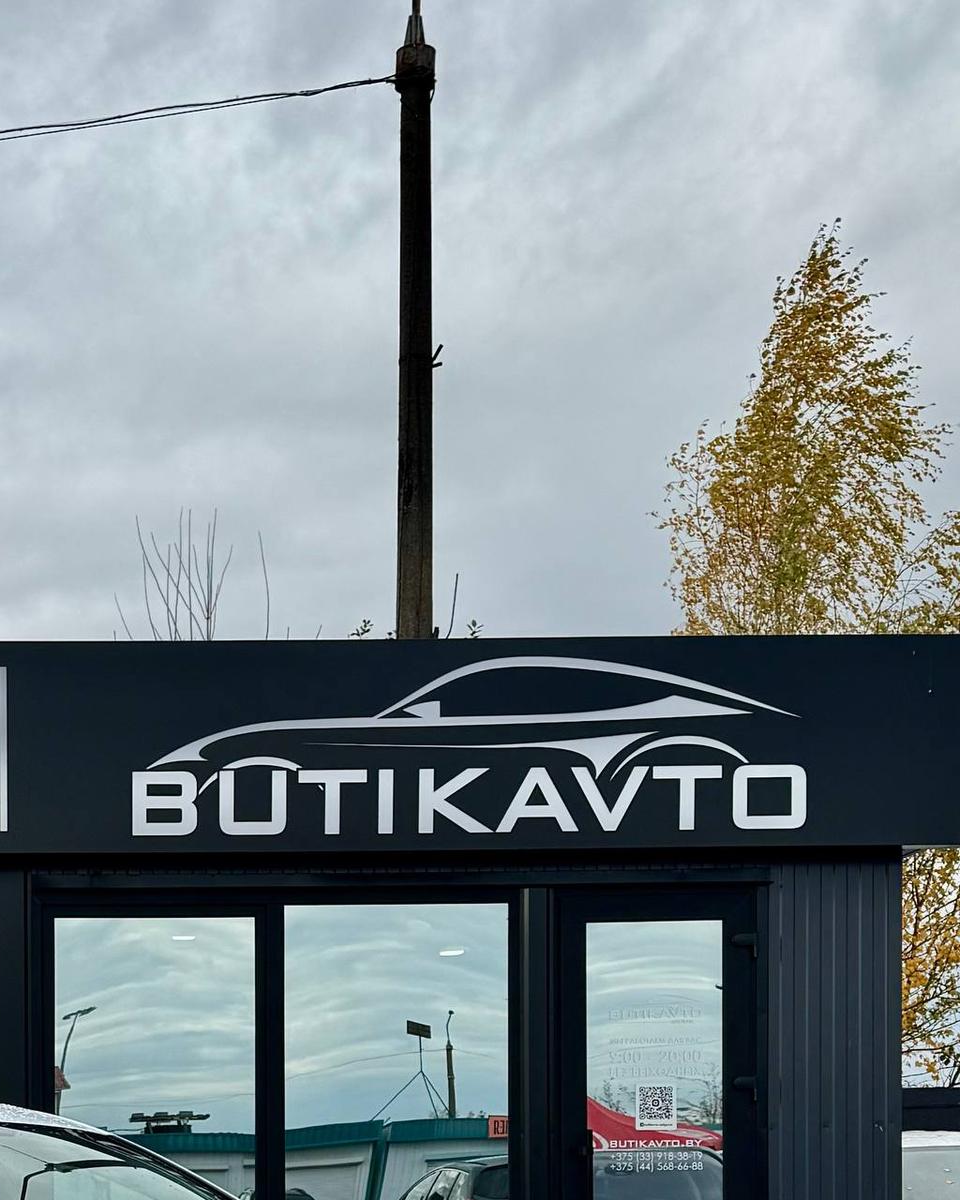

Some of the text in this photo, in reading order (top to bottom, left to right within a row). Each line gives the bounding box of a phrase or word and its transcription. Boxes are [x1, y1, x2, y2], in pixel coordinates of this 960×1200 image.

[132, 763, 807, 837] BUTIKAVTO
[609, 1139, 702, 1148] BUTIKAVTO.BY
[610, 1152, 702, 1162] +375 (33) 918-38-19
[610, 1162, 703, 1172] +375 (44) 568-66-88
